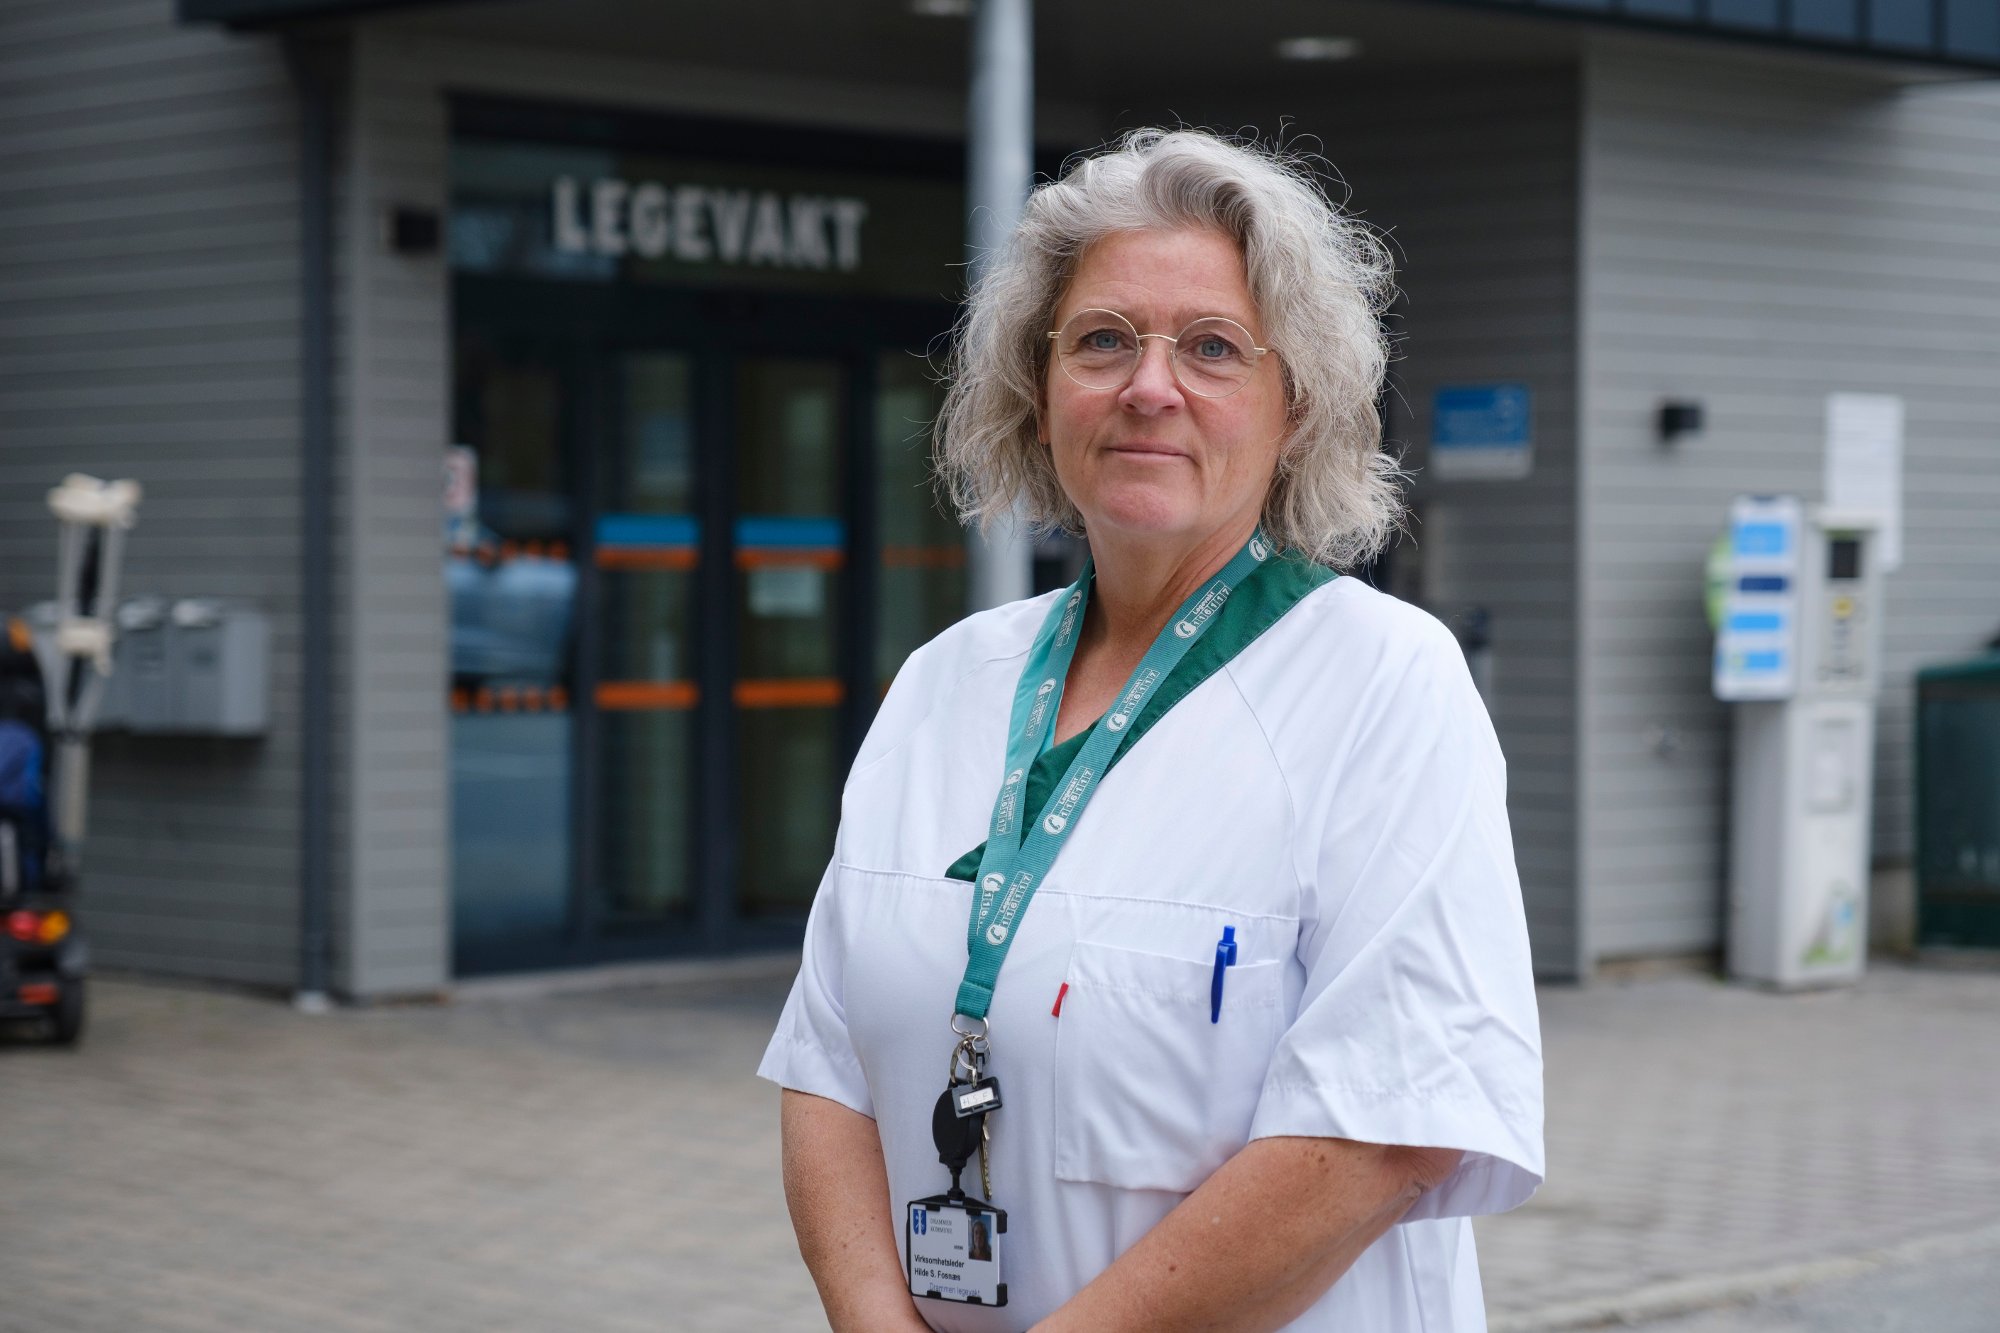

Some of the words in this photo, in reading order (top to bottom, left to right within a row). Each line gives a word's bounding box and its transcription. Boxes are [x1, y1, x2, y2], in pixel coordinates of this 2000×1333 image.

[553, 176, 867, 271] LEGEVAKT
[1192, 590, 1215, 615] Legevakt
[1058, 777, 1079, 805] Legevakt
[998, 884, 1019, 914] Legevakt
[914, 1254, 965, 1268] Virksomhetsleder
[914, 1268, 929, 1277] Hilde
